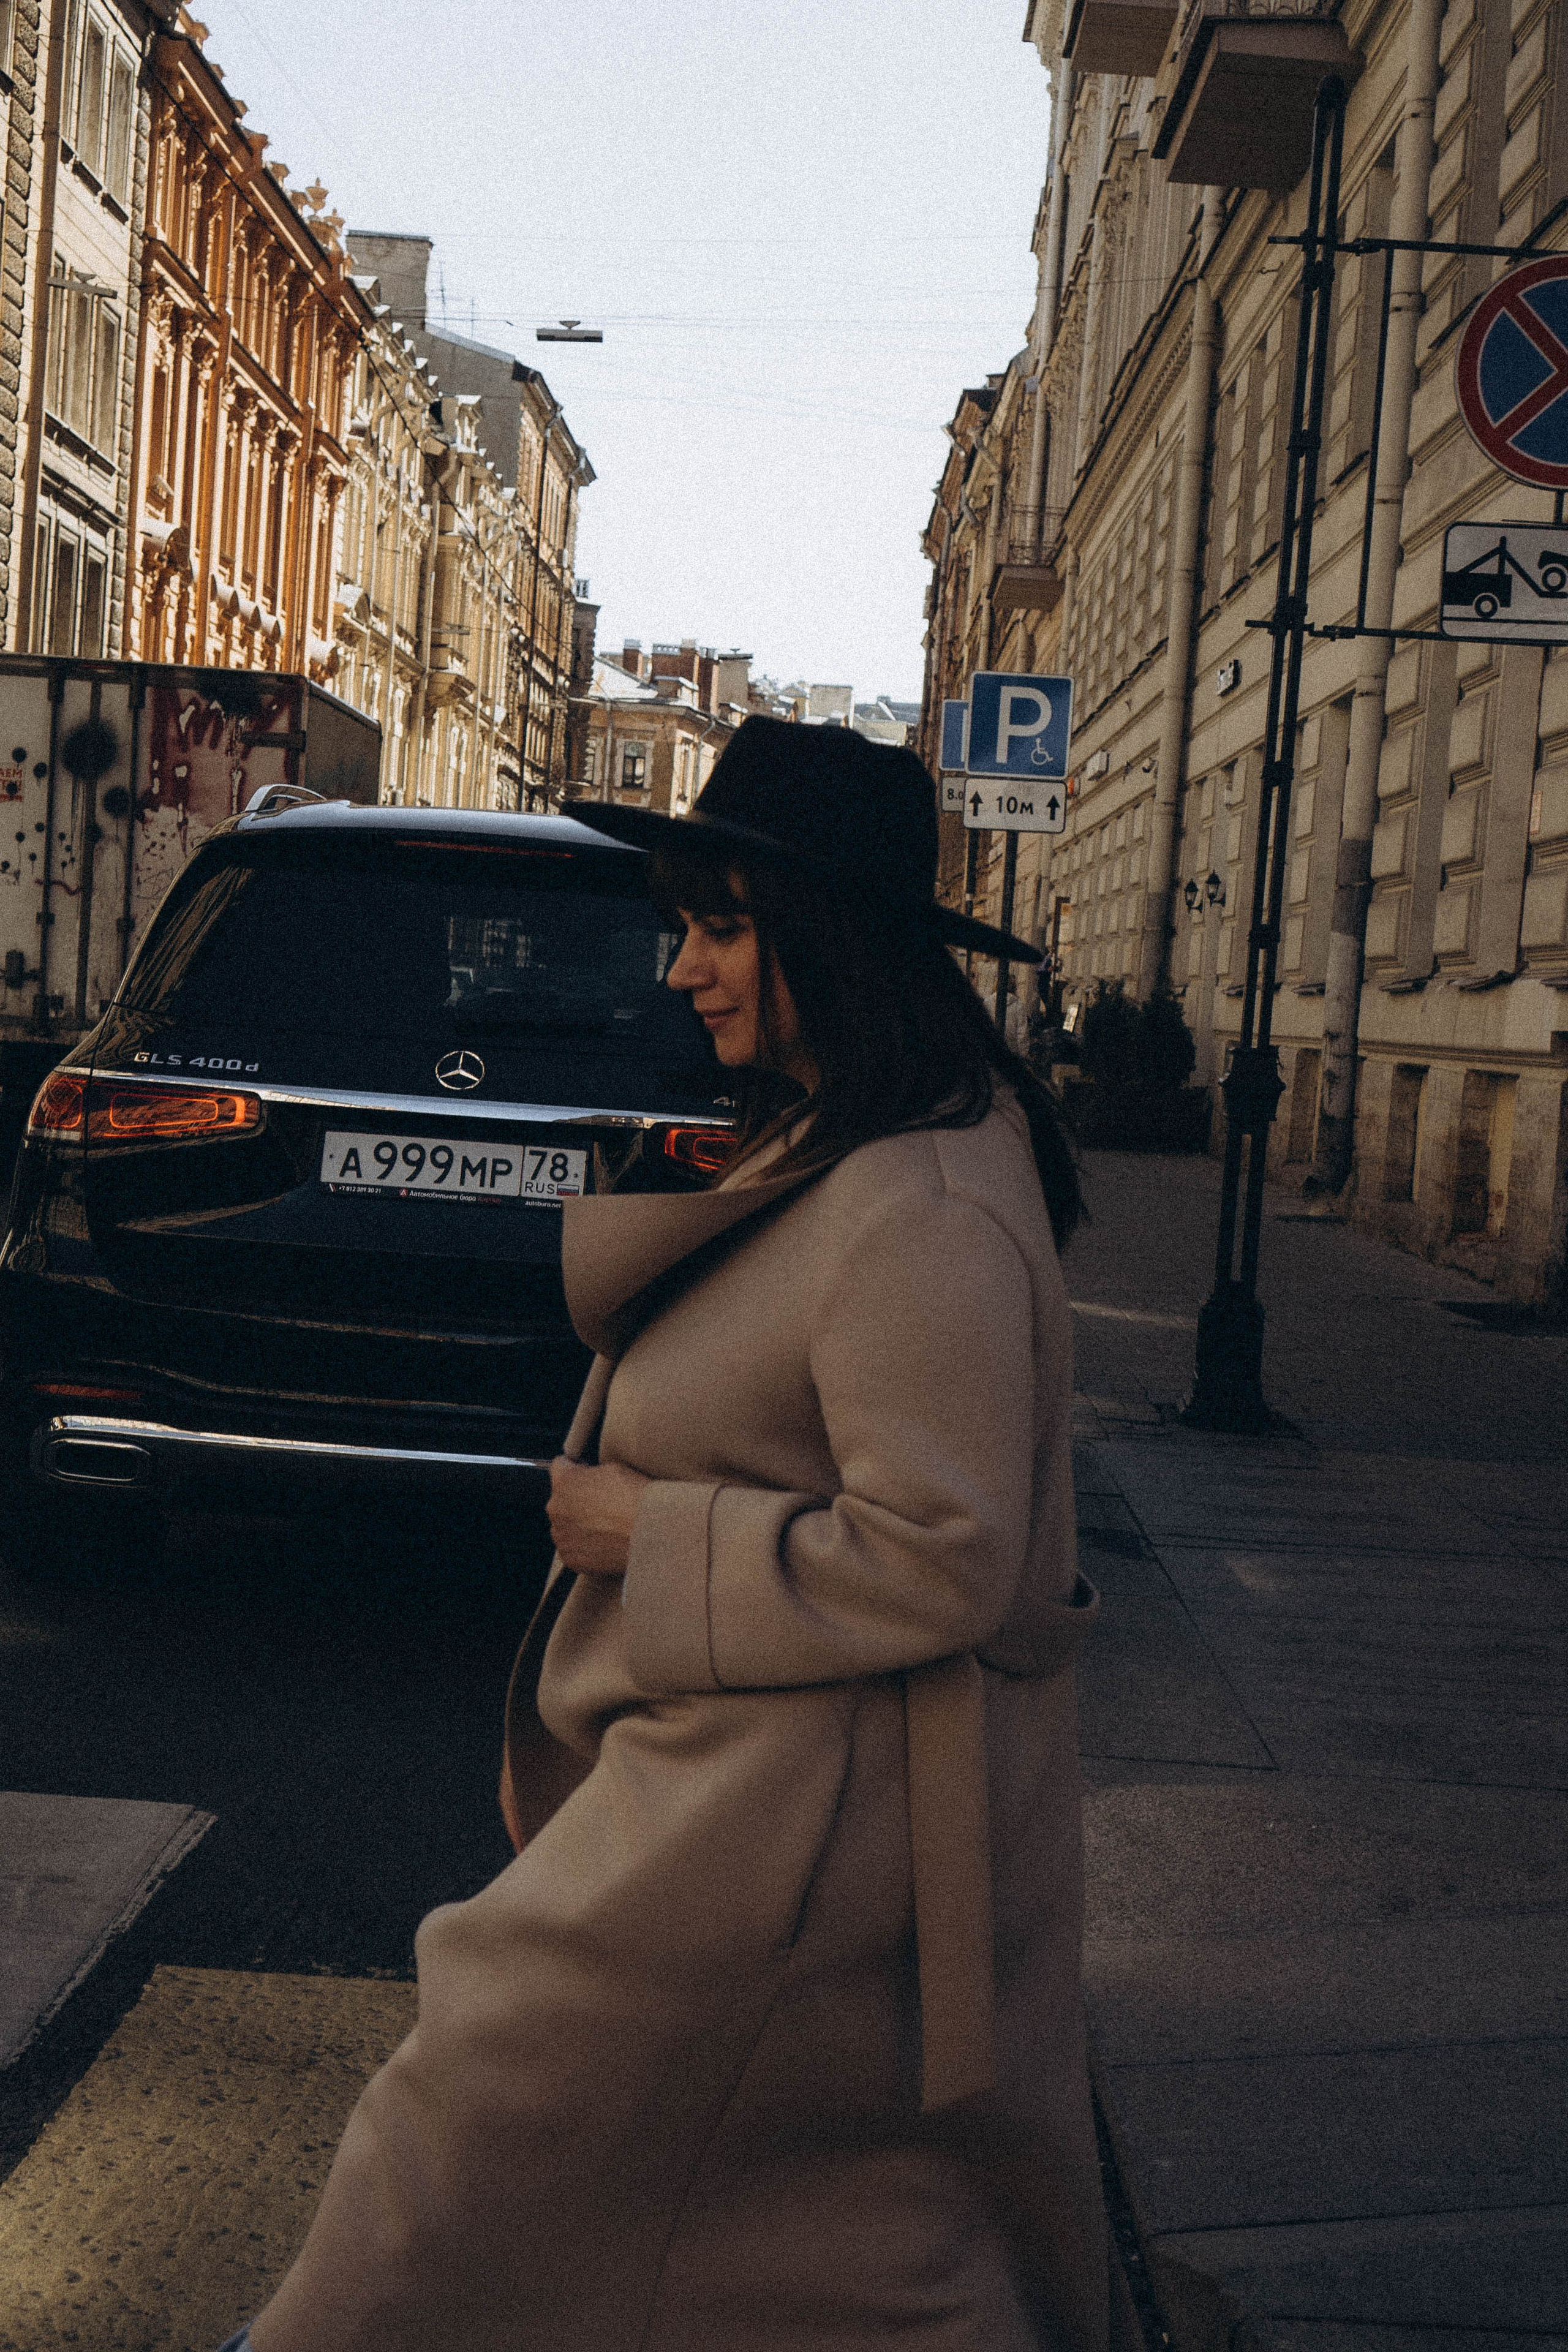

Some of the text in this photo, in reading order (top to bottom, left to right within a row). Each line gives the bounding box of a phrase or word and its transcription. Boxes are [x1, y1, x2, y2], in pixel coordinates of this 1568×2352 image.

[995, 685, 1052, 764] P
[134, 1052, 183, 1065] GLS
[529, 1150, 568, 1182] 78
[525, 1182, 555, 1194] RUS
[409, 1190, 458, 1200] Автомобильное
[459, 1194, 477, 1202] бюро
[525, 1200, 562, 1208] autoburo.net
